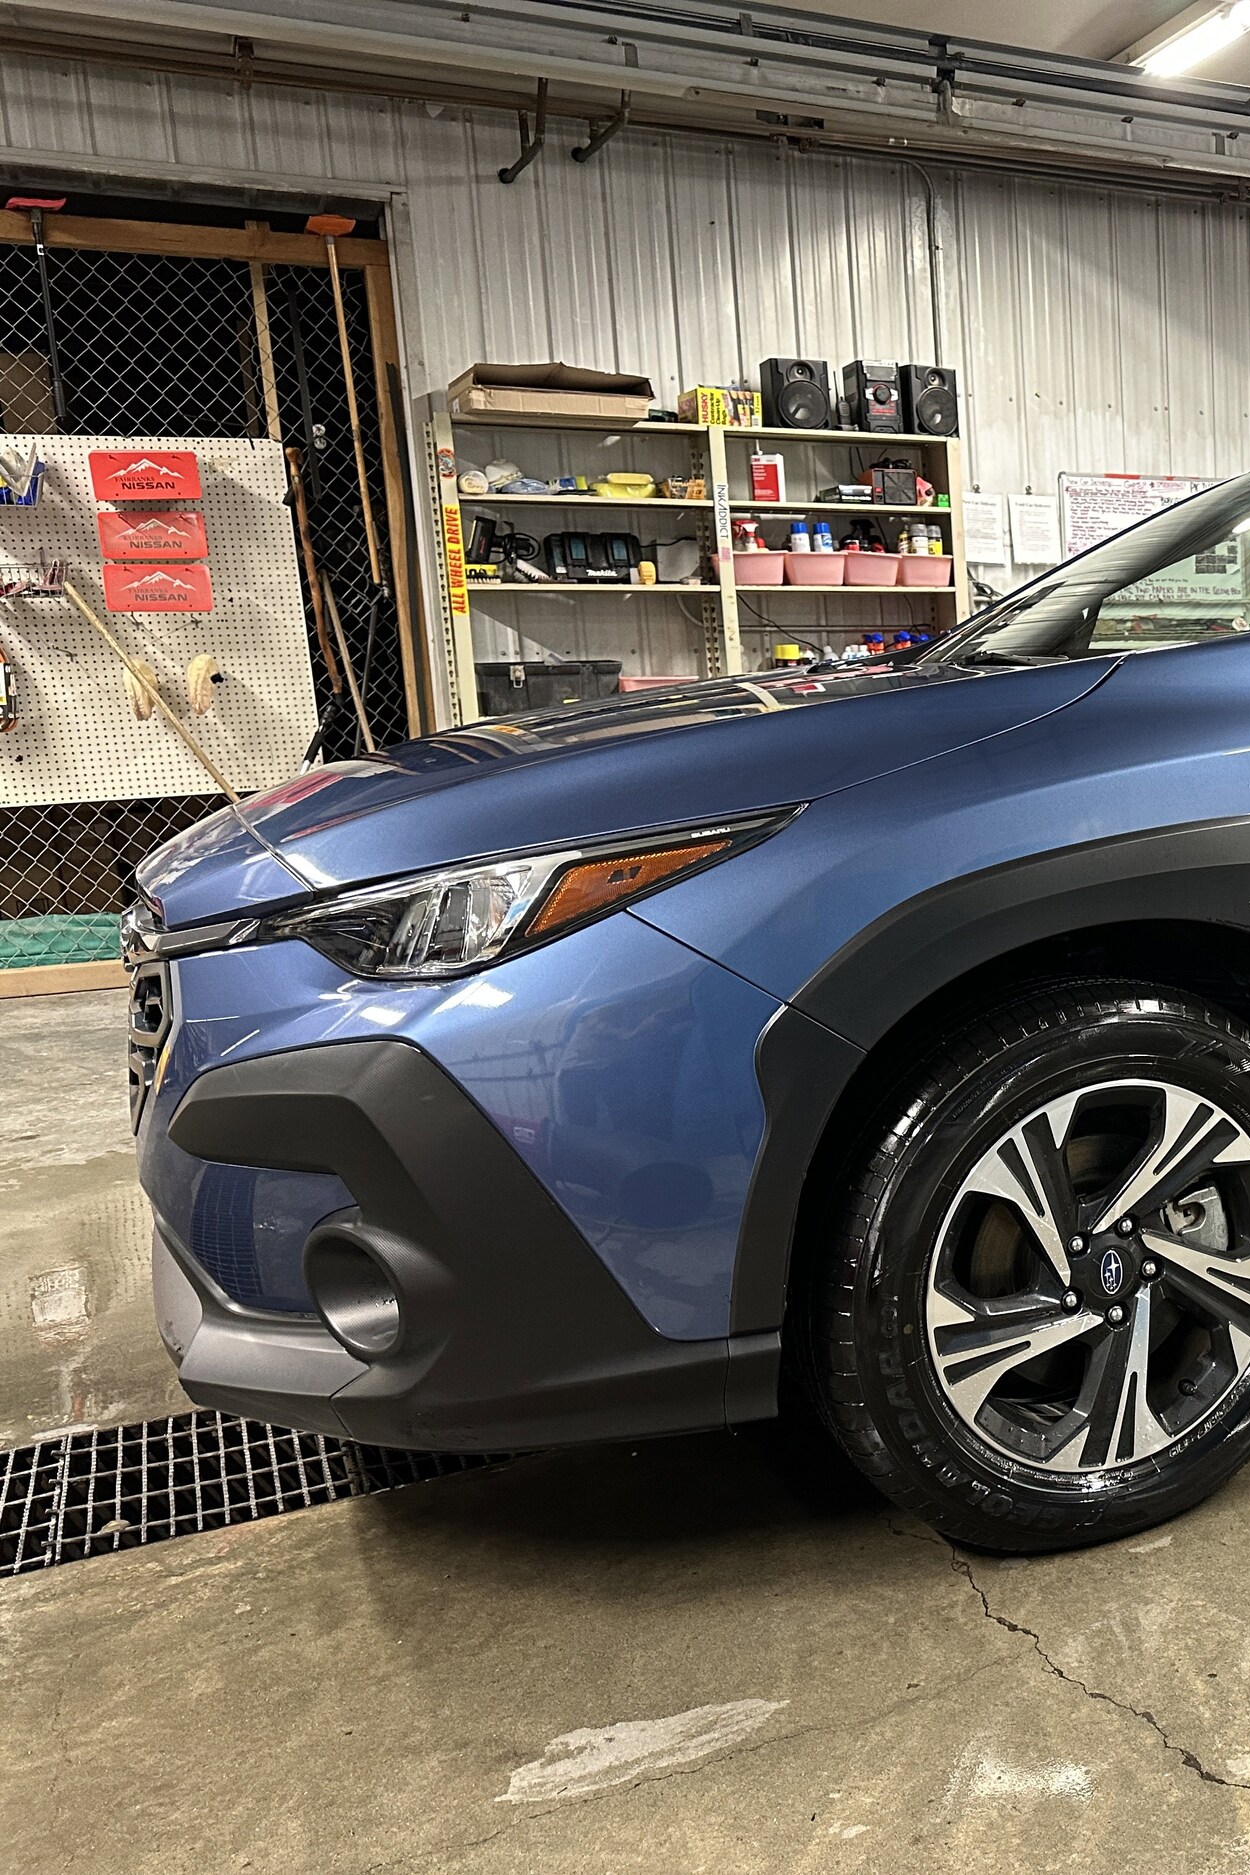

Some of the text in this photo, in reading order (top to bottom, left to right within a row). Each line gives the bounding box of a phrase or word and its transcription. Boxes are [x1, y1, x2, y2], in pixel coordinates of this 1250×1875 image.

[700, 392, 709, 424] HUSKY
[121, 482, 176, 490] NISSAN
[129, 540, 183, 549] NISSAN
[444, 506, 468, 614] ALL WHEEL DRIVE
[585, 569, 618, 577] makita
[134, 593, 188, 602] NISSAN
[690, 826, 731, 839] SUBARU
